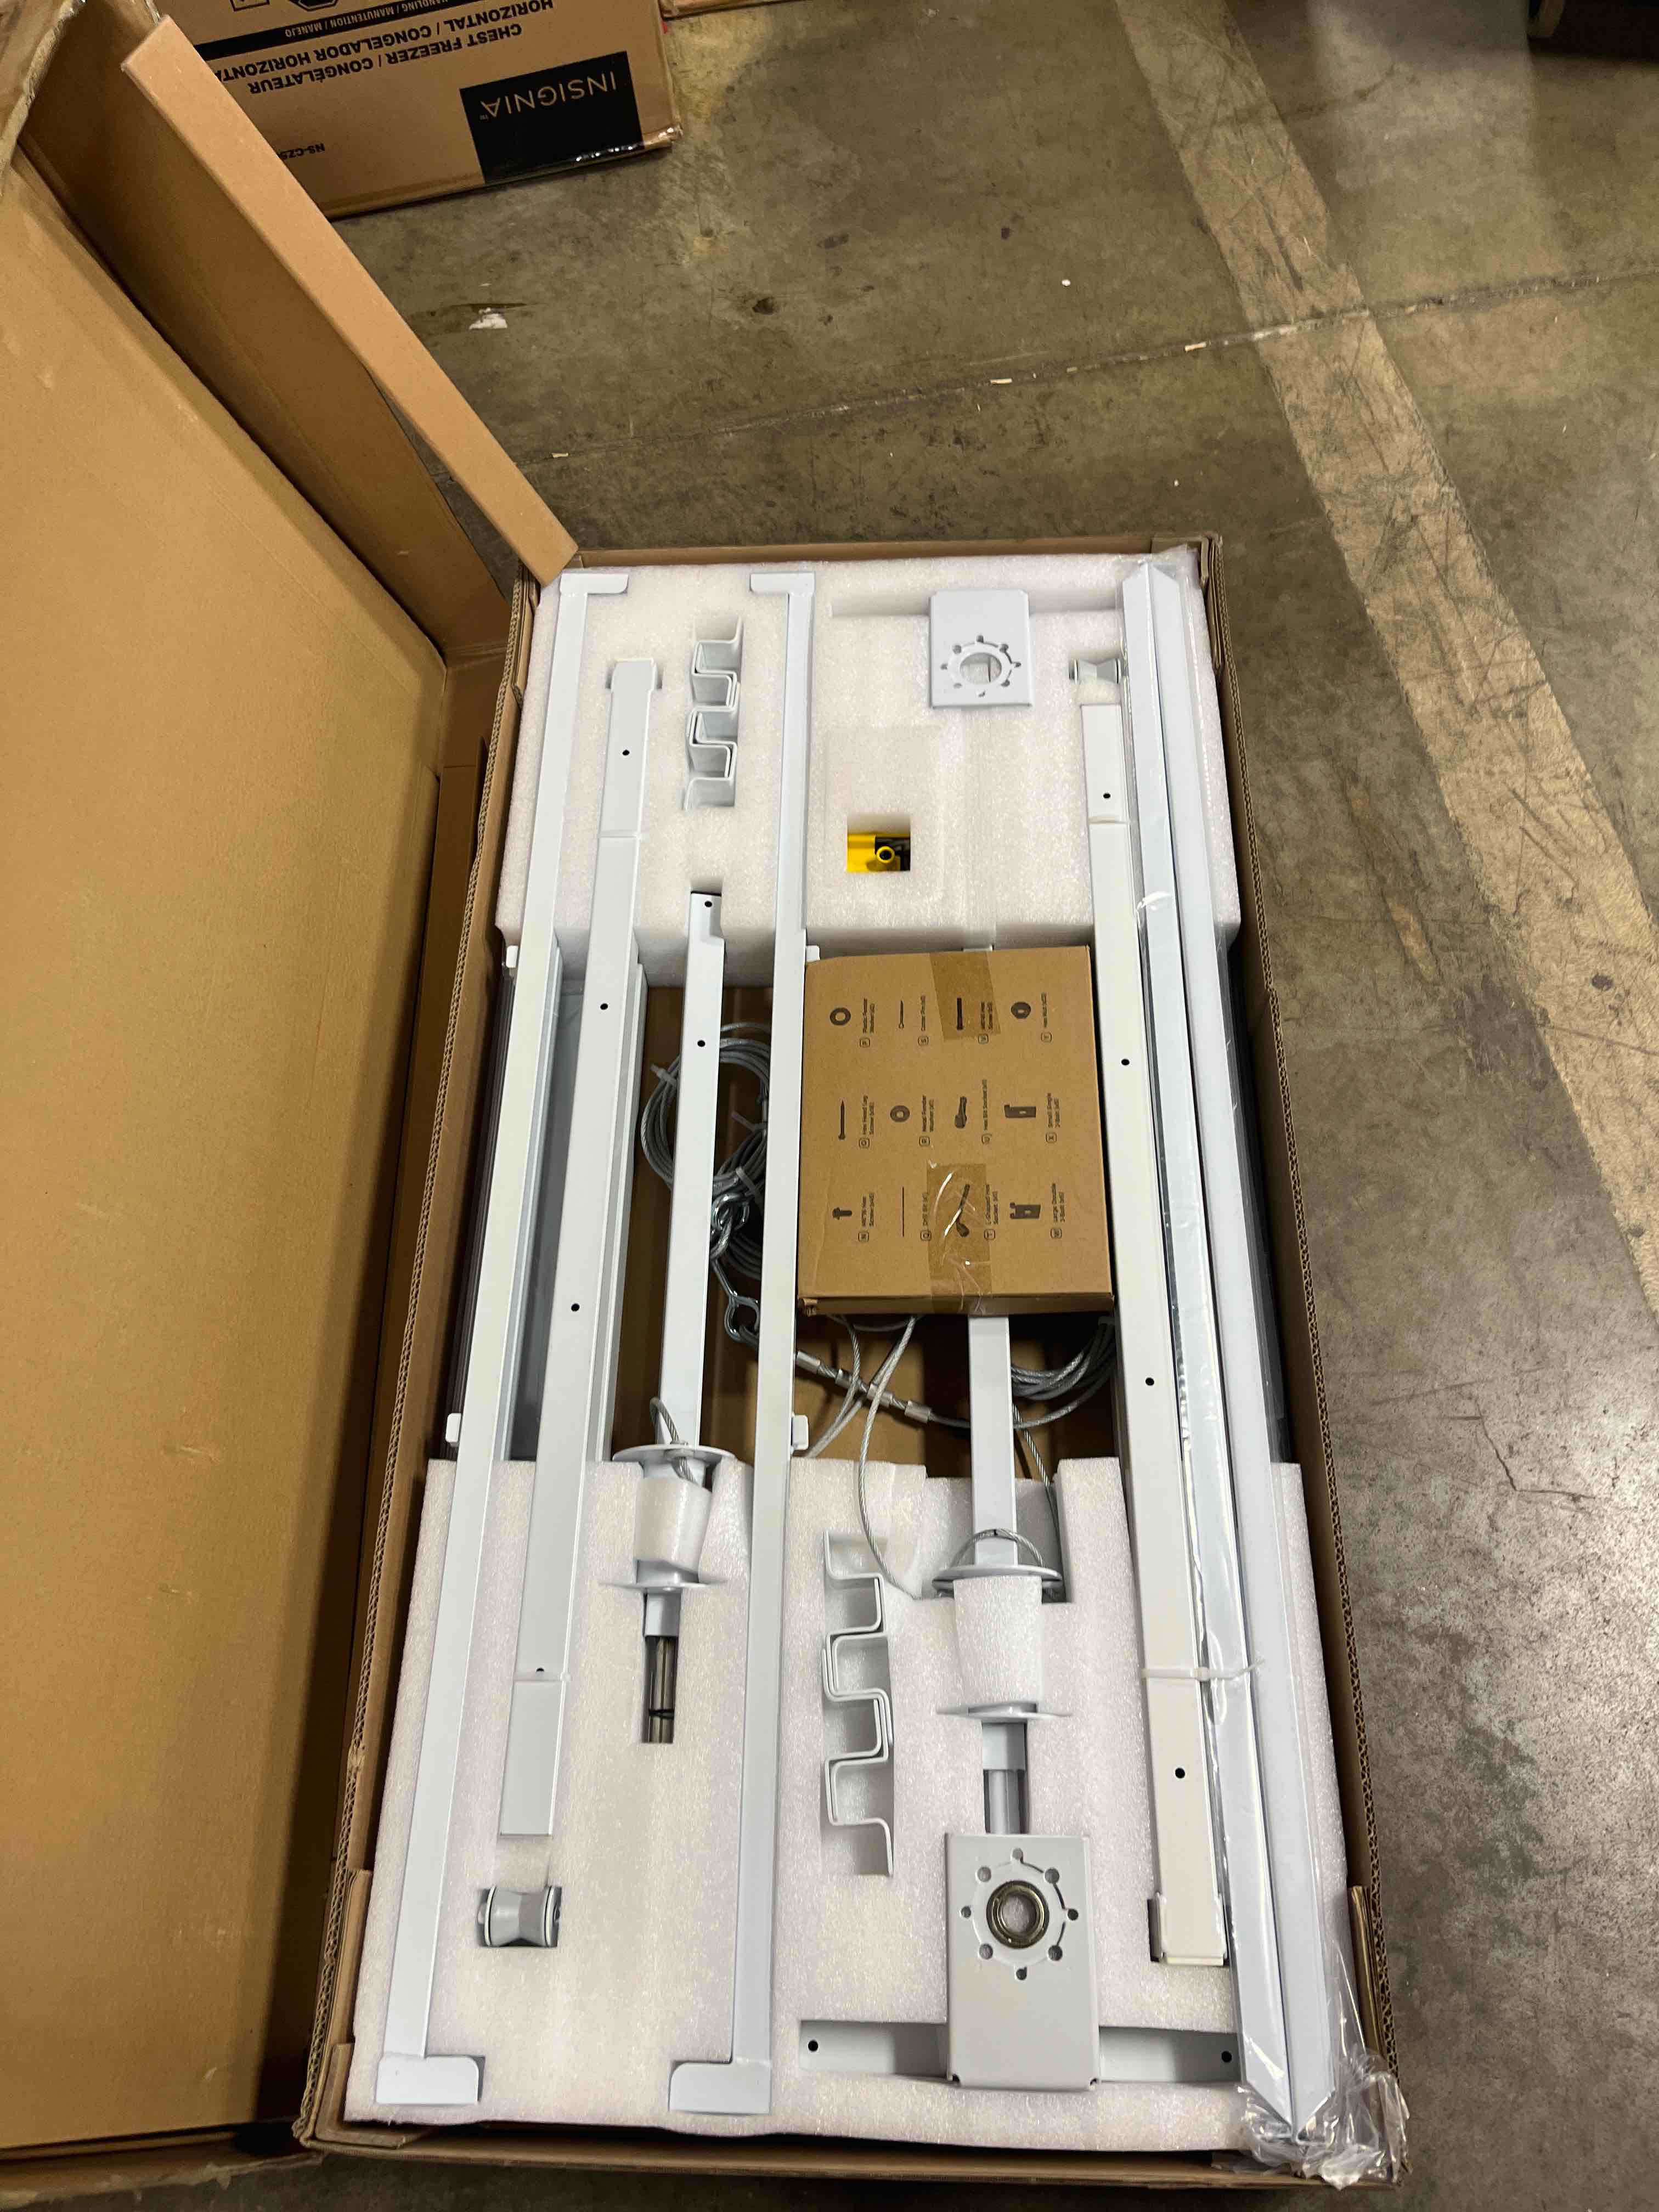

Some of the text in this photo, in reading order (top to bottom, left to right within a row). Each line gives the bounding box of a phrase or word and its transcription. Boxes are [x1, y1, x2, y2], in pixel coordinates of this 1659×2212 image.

[285, 22, 323, 38] MANEJO
[330, 7, 395, 27] MANUTENTION
[437, 22, 440, 36] /
[444, 0, 554, 32] HORIZONTAL
[247, 24, 522, 94] CHEST FREEZER / CONGÉLATEUR
[316, 25, 432, 62] CONGELADOR
[481, 71, 617, 118] INSIGNIA
